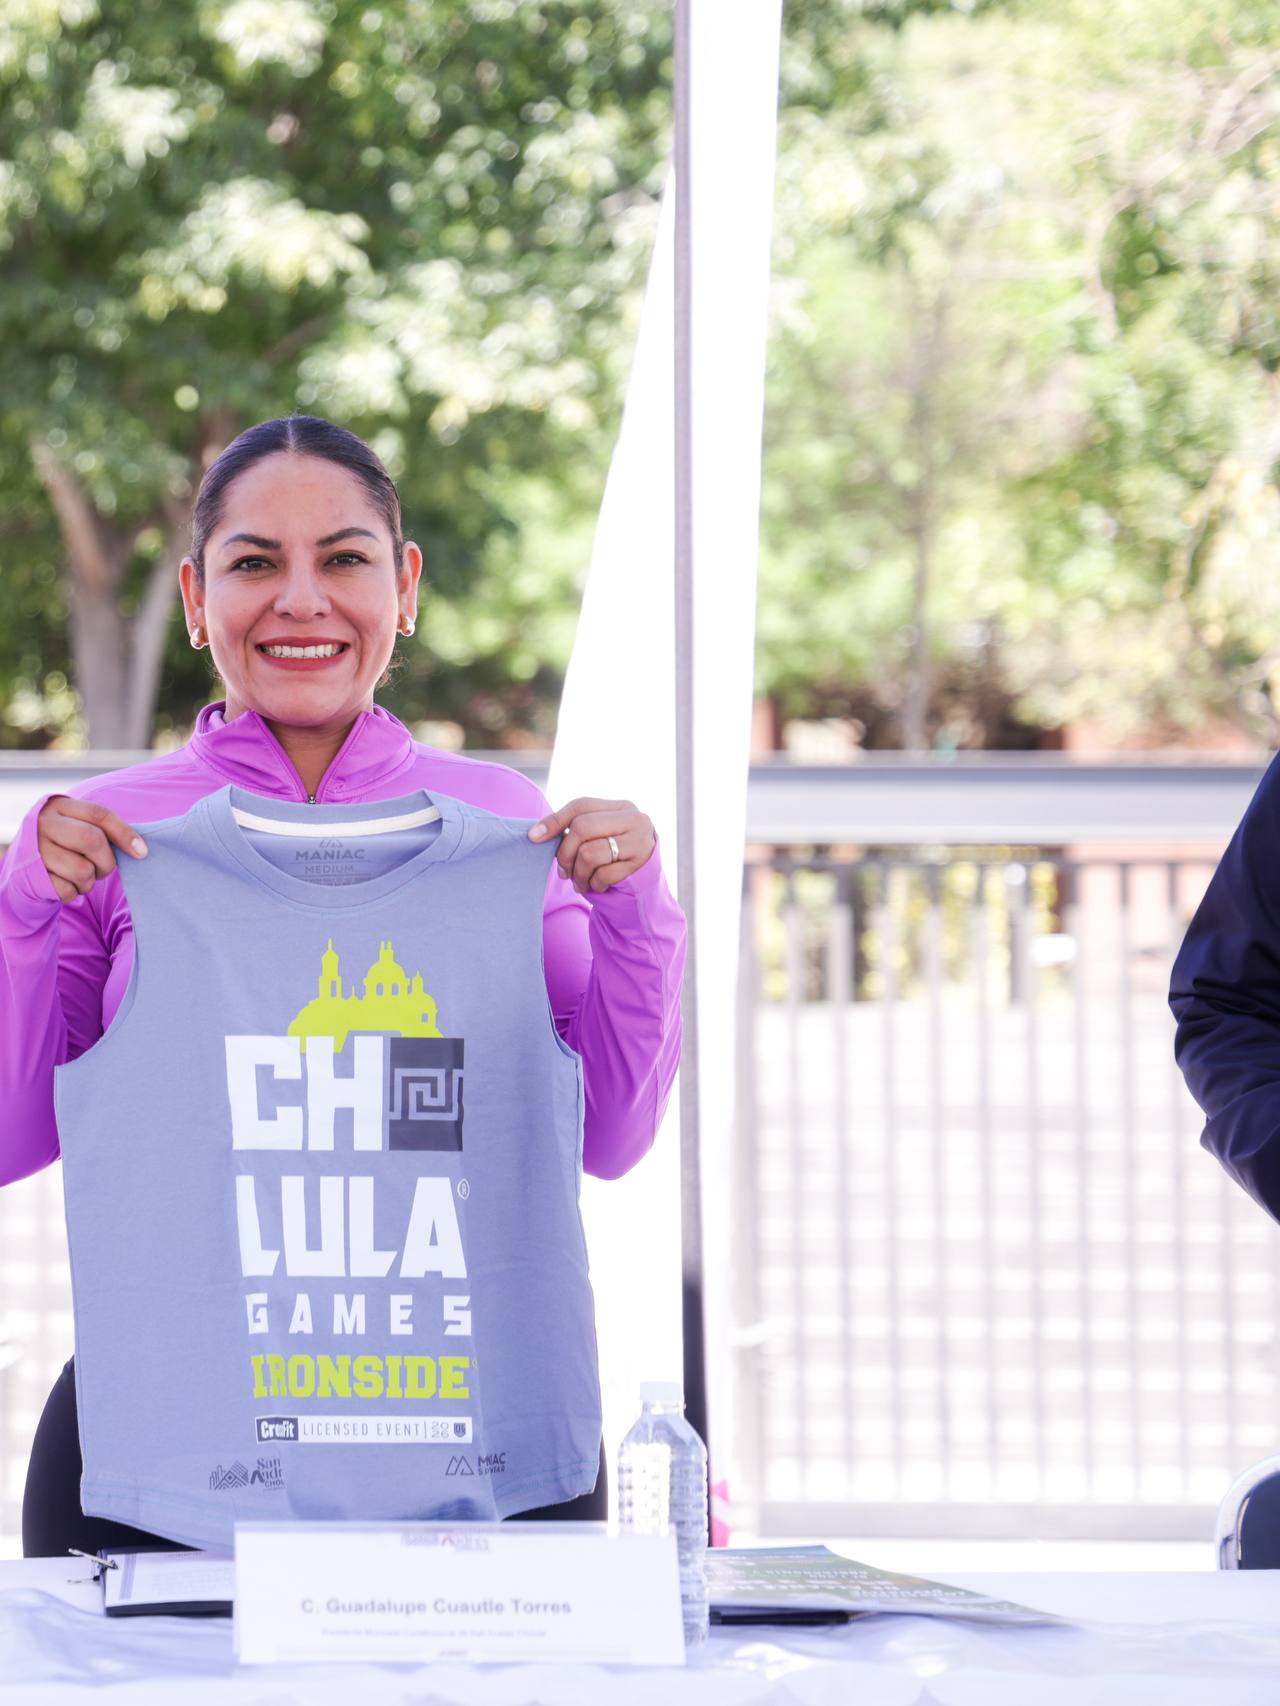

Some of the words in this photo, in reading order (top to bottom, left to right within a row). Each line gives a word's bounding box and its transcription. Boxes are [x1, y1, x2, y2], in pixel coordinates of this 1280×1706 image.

[295, 849, 366, 861] MANIAC
[304, 864, 354, 875] MEDIUM
[245, 1293, 472, 1336] GAMES
[250, 1354, 470, 1400] IRONSIDE
[303, 1422, 369, 1436] LICENSED
[376, 1422, 420, 1436] EVENT
[301, 1599, 320, 1615] C.
[326, 1598, 427, 1618] Guadalupe
[433, 1598, 505, 1615] Cuautle
[510, 1598, 572, 1615] Torres
